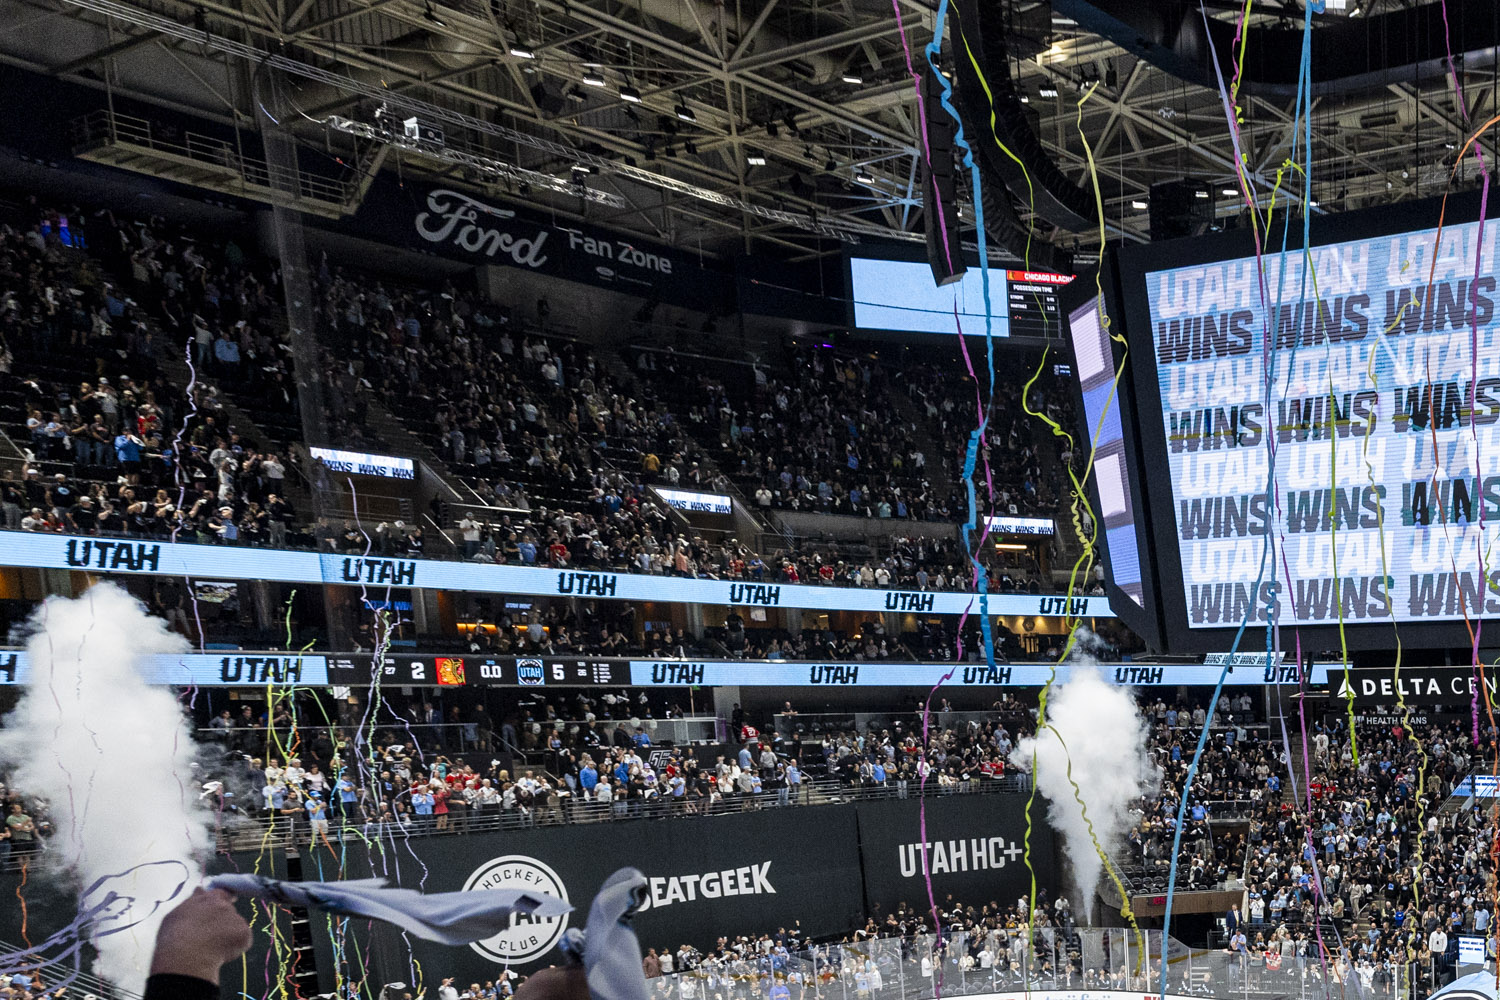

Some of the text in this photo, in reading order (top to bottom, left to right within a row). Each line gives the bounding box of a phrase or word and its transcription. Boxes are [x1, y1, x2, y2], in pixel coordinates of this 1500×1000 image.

[414, 189, 549, 268] Ford
[568, 229, 672, 274] Fan Zone
[1024, 272, 1051, 281] CHICAGO
[1158, 262, 1251, 319] UTAH
[1386, 223, 1498, 287] UTAH
[1156, 310, 1254, 364] WINS
[1267, 293, 1371, 351] WINS
[1383, 276, 1497, 336] WINS
[1165, 356, 1263, 410] UTAH
[1275, 342, 1377, 398] UTAH
[1168, 403, 1264, 453] WINS
[1276, 391, 1378, 443] WINS
[358, 464, 387, 476] WINS
[1178, 449, 1270, 498] UTAH
[1286, 439, 1387, 492] UTAH
[690, 502, 712, 512] WINS
[1179, 494, 1272, 540] WINS
[1286, 485, 1387, 534] WINS
[991, 524, 1035, 534] WINS WINS
[65, 539, 161, 571] UTAH
[1294, 531, 1397, 578] UTAH
[343, 557, 417, 585] UTAH
[557, 572, 617, 596] UTAH
[729, 584, 780, 605] UTAH
[885, 592, 935, 612] UTAH
[1189, 580, 1283, 624] WINS
[1295, 575, 1395, 622] WINS
[1039, 597, 1089, 616] UTAH
[219, 656, 302, 683] UTAH
[384, 666, 396, 675] 27
[410, 662, 425, 680] 2
[480, 664, 502, 679] 0.0
[521, 666, 542, 679] UTAH
[552, 664, 565, 680] 5
[651, 663, 705, 684] UTAH
[810, 666, 858, 685] UTAH
[963, 667, 1012, 685] UTAH
[1115, 667, 1164, 684] UTAH
[1264, 666, 1301, 683] UTA
[1361, 677, 1442, 696] DELTA
[1366, 716, 1428, 725] HEALTH PANS
[898, 836, 1023, 878] UTAH HC+
[482, 868, 544, 892] HOCKEY
[498, 935, 539, 951] CLUB
